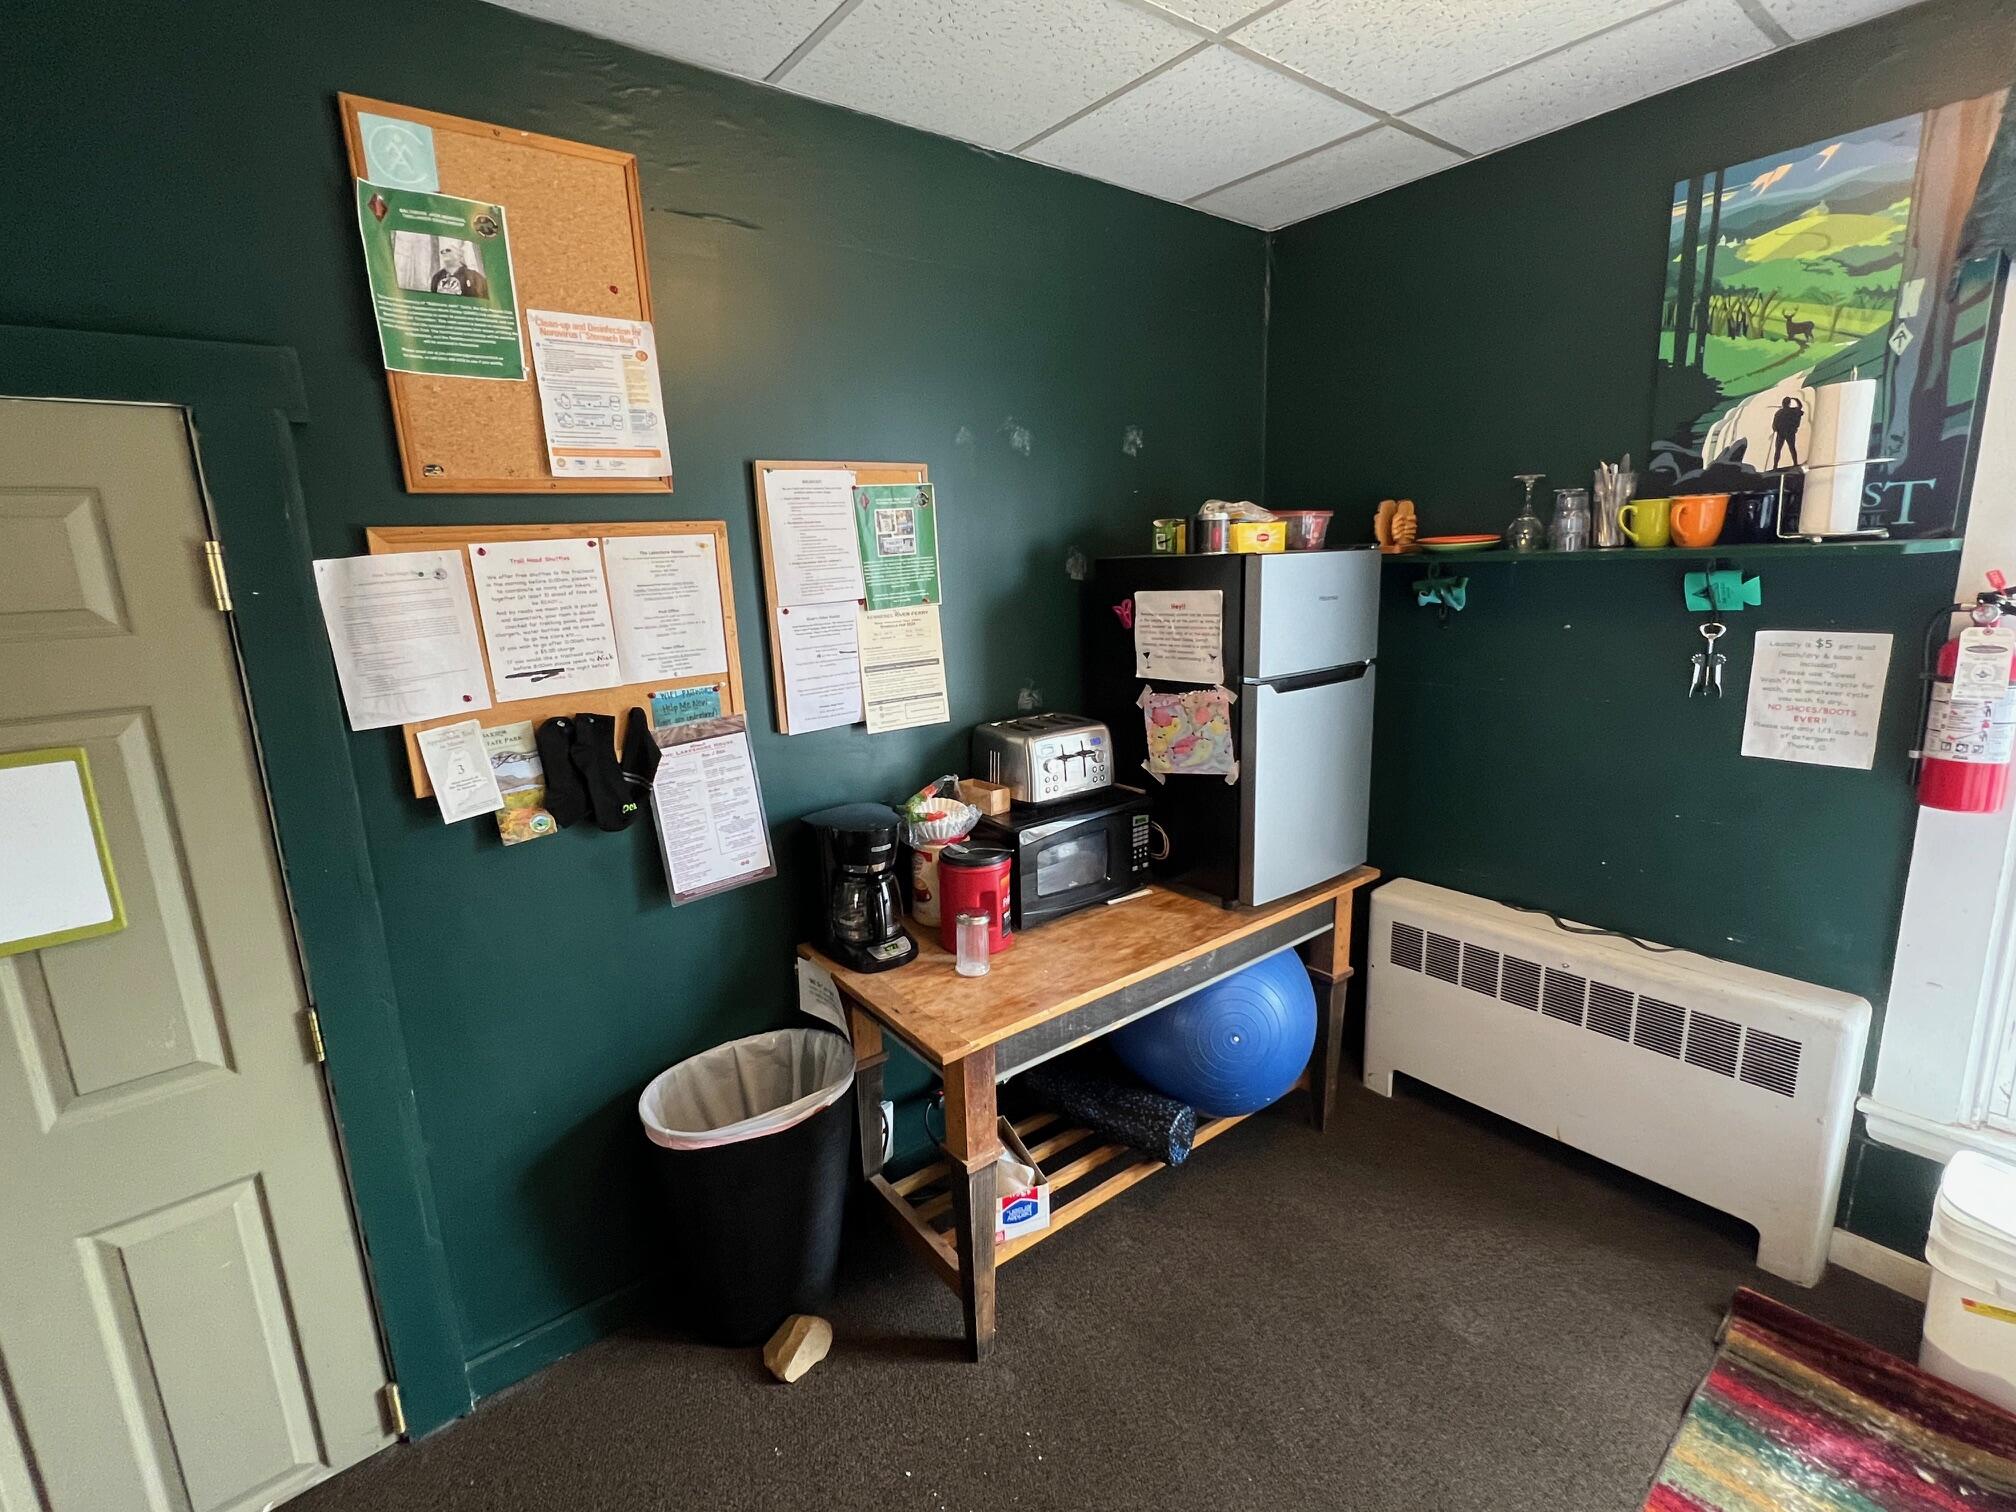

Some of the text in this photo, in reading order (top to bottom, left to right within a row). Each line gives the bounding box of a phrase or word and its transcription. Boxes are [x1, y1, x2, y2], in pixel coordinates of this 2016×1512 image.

[1769, 640, 1801, 650] Laundry
[1816, 638, 1833, 649] $5
[1786, 704, 1857, 717] SHOES/BOOTS
